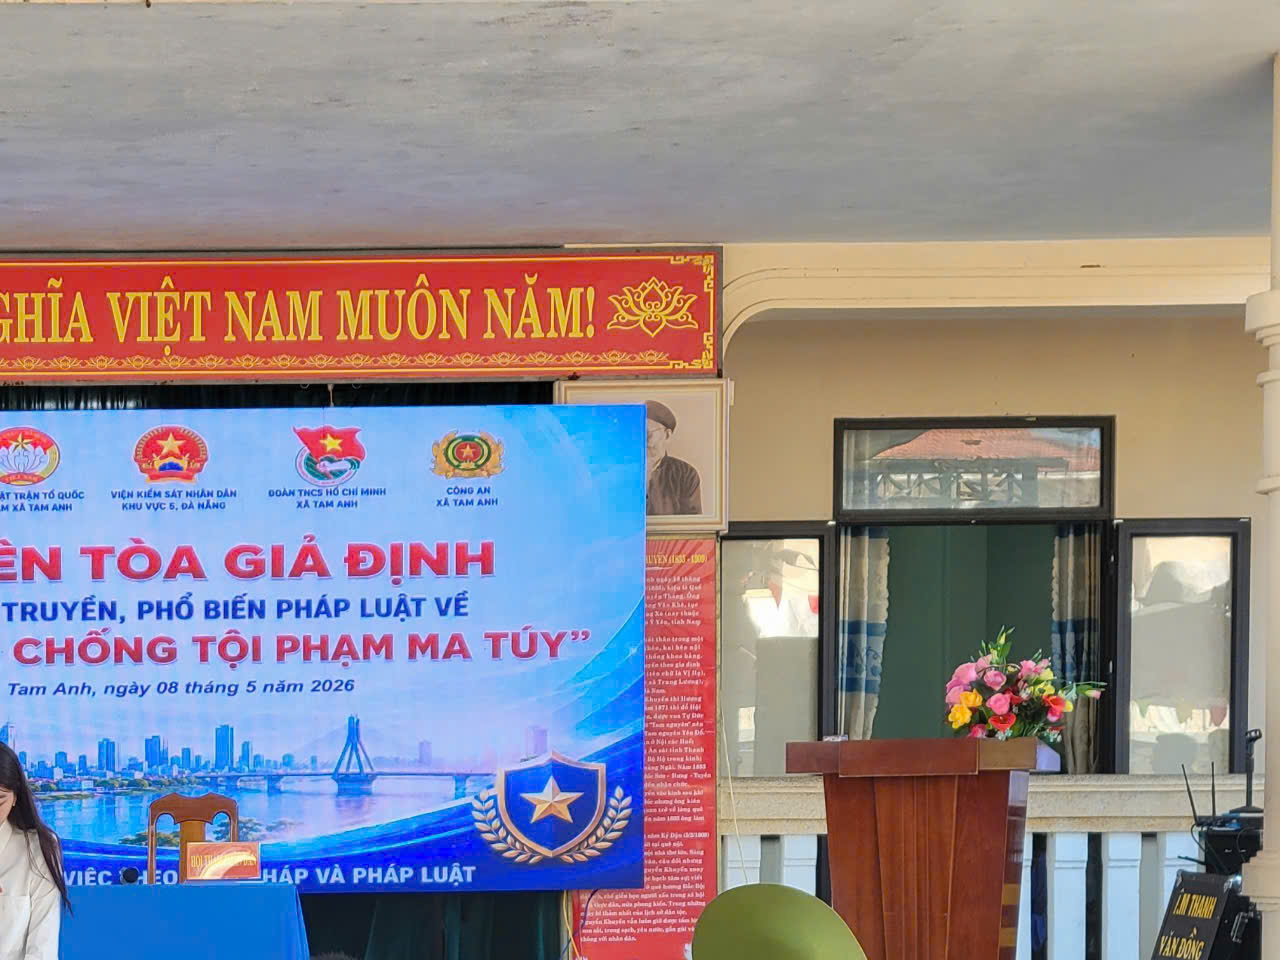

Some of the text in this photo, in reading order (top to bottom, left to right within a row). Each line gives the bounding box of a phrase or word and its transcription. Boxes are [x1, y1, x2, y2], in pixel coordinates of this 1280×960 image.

[107, 275, 212, 356] VIỆT
[225, 289, 322, 342] NAM
[336, 273, 468, 340] MUÔN
[482, 272, 596, 339] NĂM!
[14, 491, 40, 502] TRẬN
[42, 489, 54, 500] TỔ
[58, 489, 84, 500] QUỐC
[111, 488, 236, 500] VIỆN KIỂM SÁT NHÂN DÂN
[269, 488, 295, 497] ĐOÀN
[326, 485, 340, 496] HỒ
[342, 486, 358, 496] CHÍ
[446, 486, 474, 494] CÔNG
[13, 503, 25, 512] XÃ
[296, 500, 310, 508] XÃ
[436, 498, 449, 506] XÃ
[79, 537, 206, 582] TÒA
[223, 533, 331, 580] GIẢ
[344, 539, 496, 586] ĐỊNH
[2, 594, 126, 625] TRUYỀN,
[138, 591, 194, 621] PHỔ
[204, 592, 268, 621] BIẾN
[276, 591, 351, 620] PHÁP
[360, 592, 428, 624] LUẬT
[435, 588, 470, 618] VỀ
[13, 626, 178, 667] CHỐNG
[192, 629, 261, 676] TỘI
[276, 631, 397, 673] PHẠM
[407, 630, 470, 662] MA
[483, 624, 591, 661] TÚY”
[8, 678, 355, 700] Tam Anh, ngày 08 tháng 5 năm 2026
[262, 865, 308, 884] HÁP
[316, 864, 346, 884] VÀ
[352, 863, 413, 884] PHÁP
[420, 862, 476, 886] LUẬT
[1188, 894, 1217, 920] THANH
[1159, 927, 1205, 960] VĂN ĐỒNG
